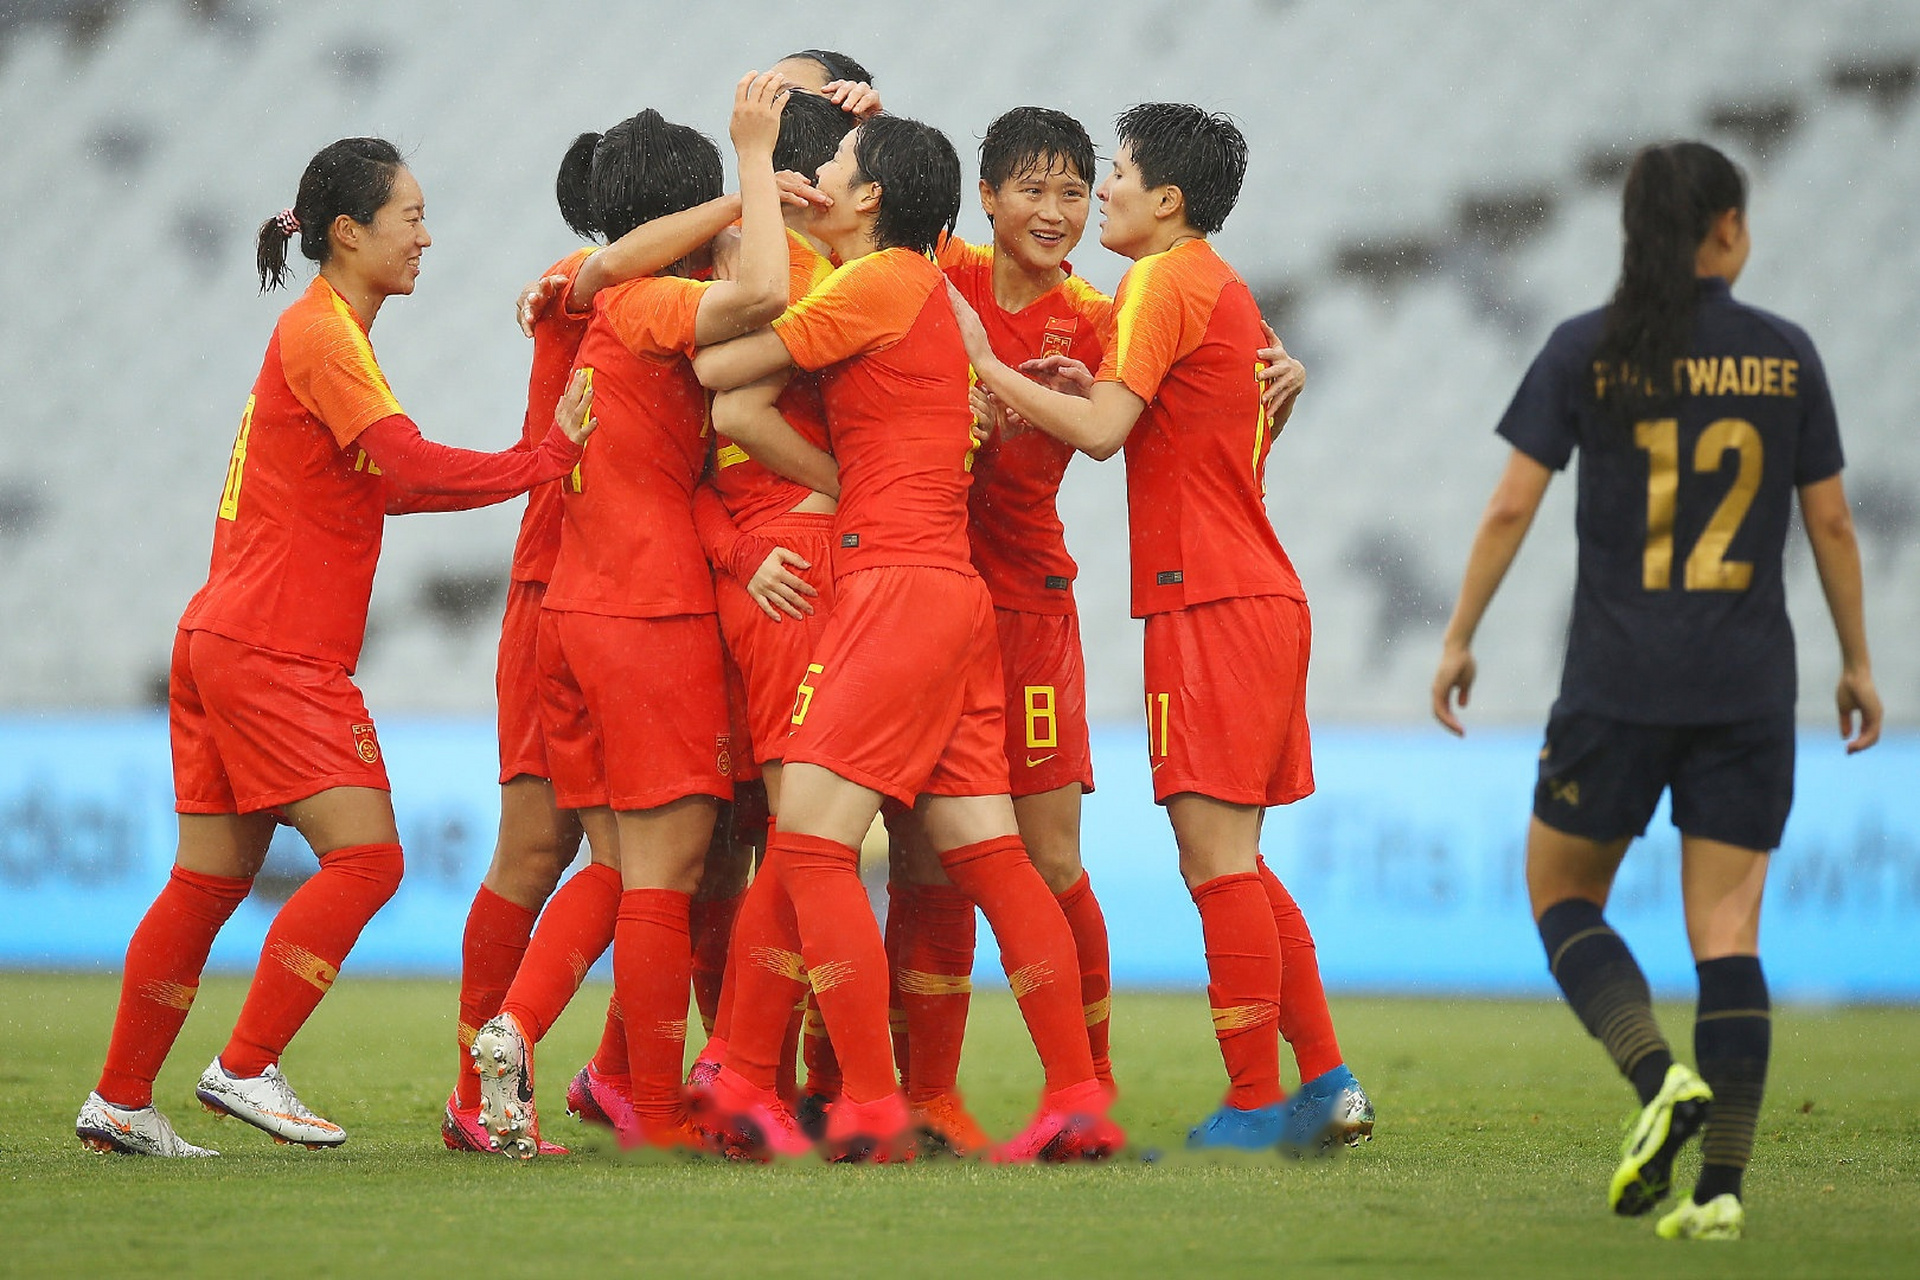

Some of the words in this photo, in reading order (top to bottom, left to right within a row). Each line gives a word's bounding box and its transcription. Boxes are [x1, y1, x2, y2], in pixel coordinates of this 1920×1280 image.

[1633, 416, 1765, 593] 12
[1024, 685, 1058, 748] 8
[1146, 692, 1170, 757] 11
